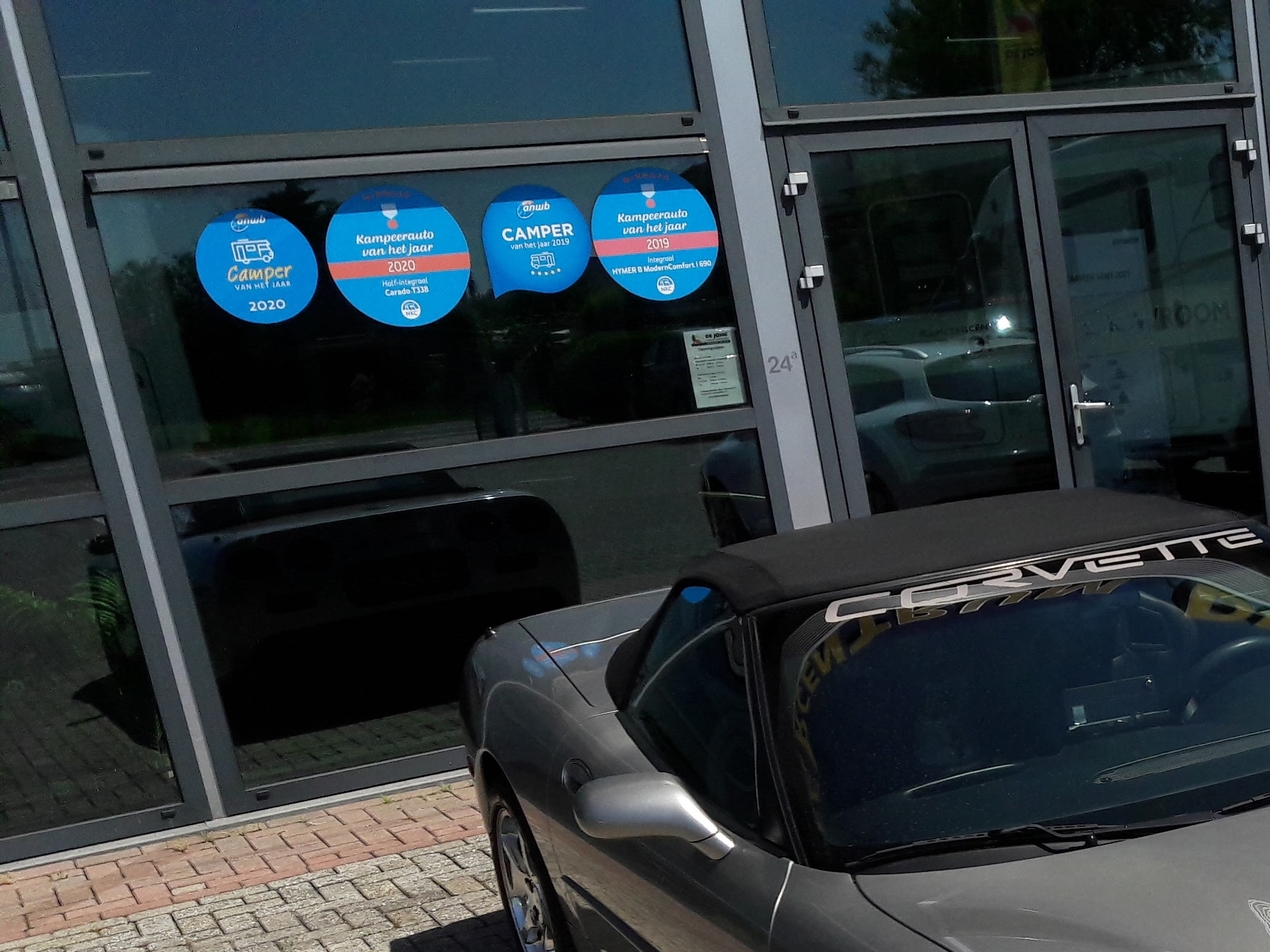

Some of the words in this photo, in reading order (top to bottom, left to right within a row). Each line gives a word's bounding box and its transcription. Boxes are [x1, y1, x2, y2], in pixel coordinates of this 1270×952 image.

[523, 201, 551, 212] anwb
[236, 215, 266, 226] anwb
[617, 209, 688, 224] Kampeerauto
[501, 223, 575, 242] CAMPER
[623, 226, 644, 235] van
[646, 222, 663, 233] het
[663, 222, 688, 234] jaar
[356, 229, 435, 245] Kampeerauto
[524, 241, 537, 249] het
[537, 241, 551, 249] jaar
[551, 238, 570, 247] 2019
[362, 248, 386, 257] van
[388, 244, 407, 255] het
[408, 243, 434, 256] jaar
[646, 238, 670, 250] 2019
[647, 255, 675, 263] Integraal
[387, 259, 416, 273] 2020
[612, 266, 637, 275] HYMER
[643, 262, 695, 272] ModernComfort
[227, 264, 293, 285] Camper
[272, 280, 291, 288] JAAR
[385, 288, 411, 297] Carado
[249, 299, 286, 312] 2020
[825, 527, 1264, 623] CORVETTE
